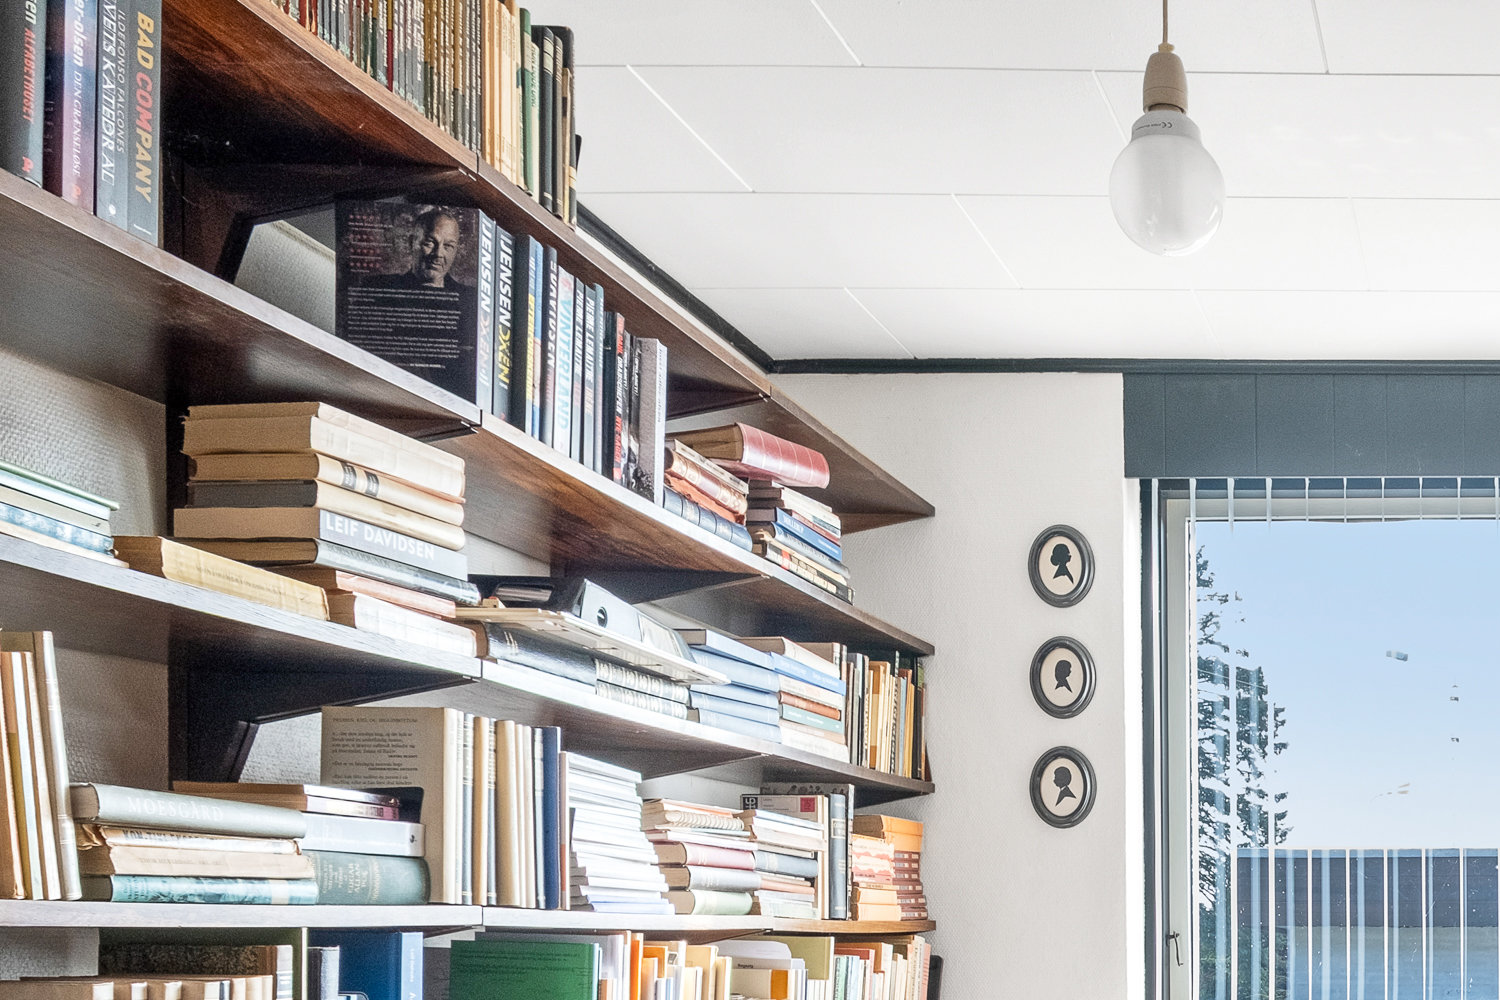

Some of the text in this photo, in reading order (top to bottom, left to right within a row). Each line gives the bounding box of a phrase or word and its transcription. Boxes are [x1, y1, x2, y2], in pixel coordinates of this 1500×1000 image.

[22, 28, 37, 124] ALFABETHUSET
[73, 70, 82, 98] DEN
[117, 10, 125, 153] ILDEFONSO FALCONES
[135, 12, 154, 202] BAD COMPANY
[72, 100, 82, 177] GRÆNSELØSE
[101, 57, 117, 186] KATEDRAL
[480, 224, 491, 311] JENSEN
[500, 240, 512, 328] JENSEN
[557, 300, 572, 430] VINTERLAND
[326, 512, 435, 562] LEIF DAVIDSEN
[128, 796, 225, 822] MOESGÅRD
